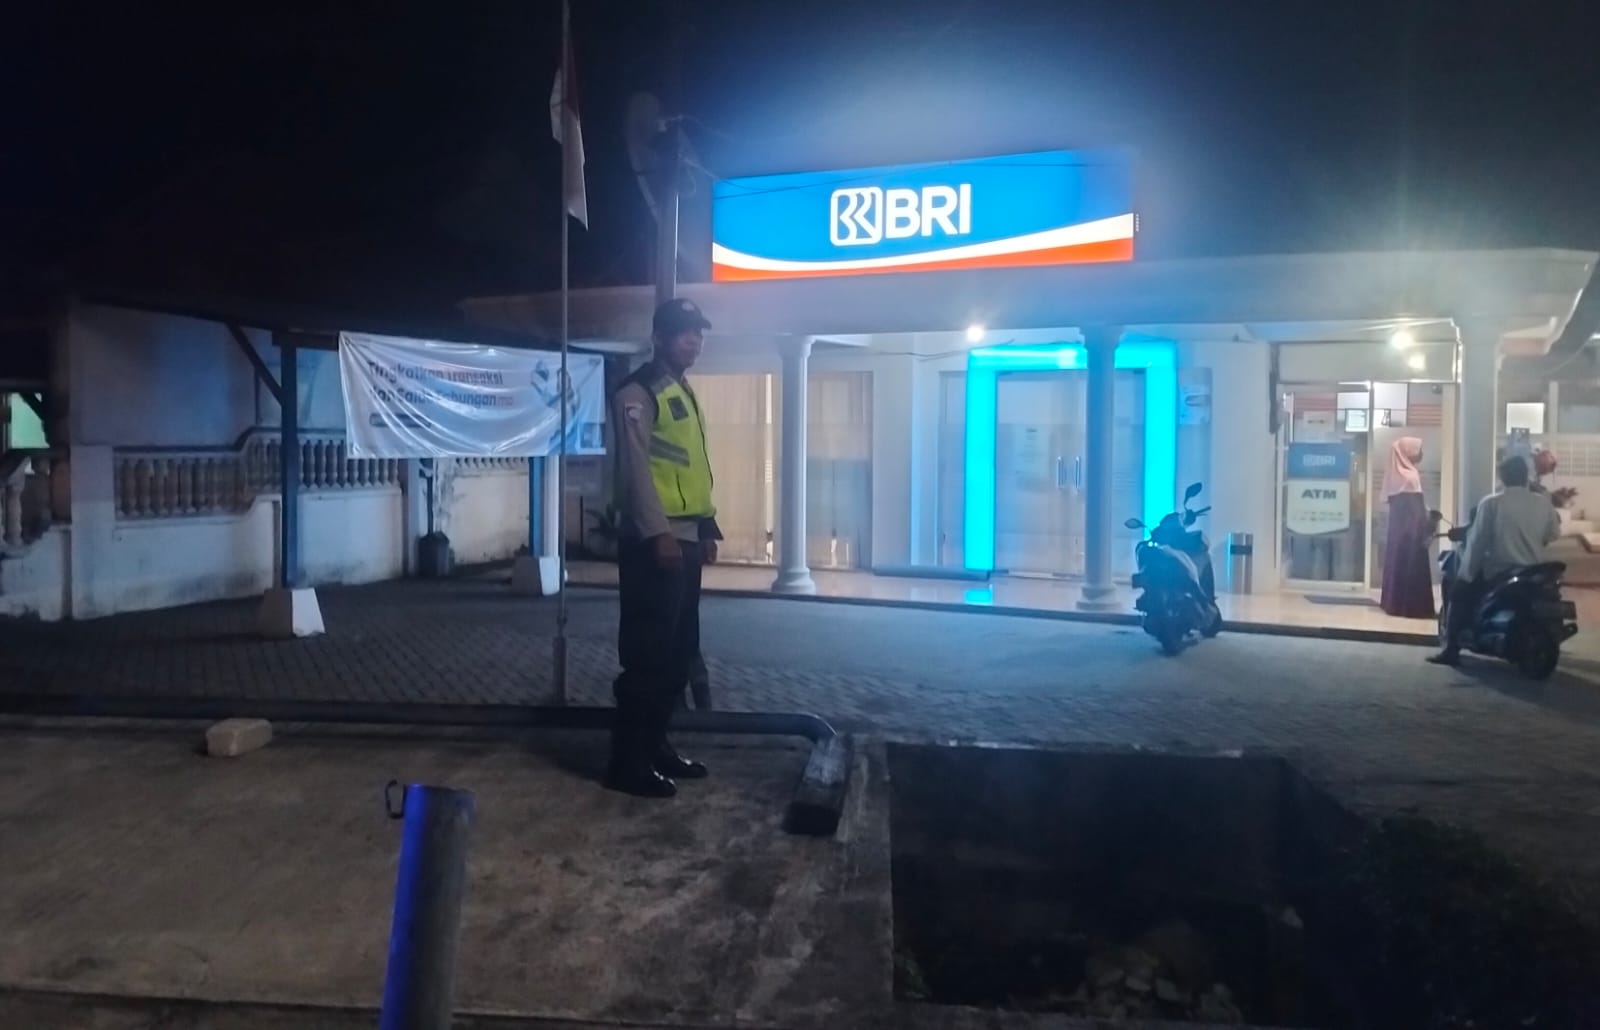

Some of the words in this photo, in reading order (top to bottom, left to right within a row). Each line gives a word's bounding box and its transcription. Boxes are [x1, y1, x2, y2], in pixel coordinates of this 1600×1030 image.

[885, 183, 972, 239] BRI
[397, 387, 433, 405] Sal
[1301, 489, 1337, 499] ATM
